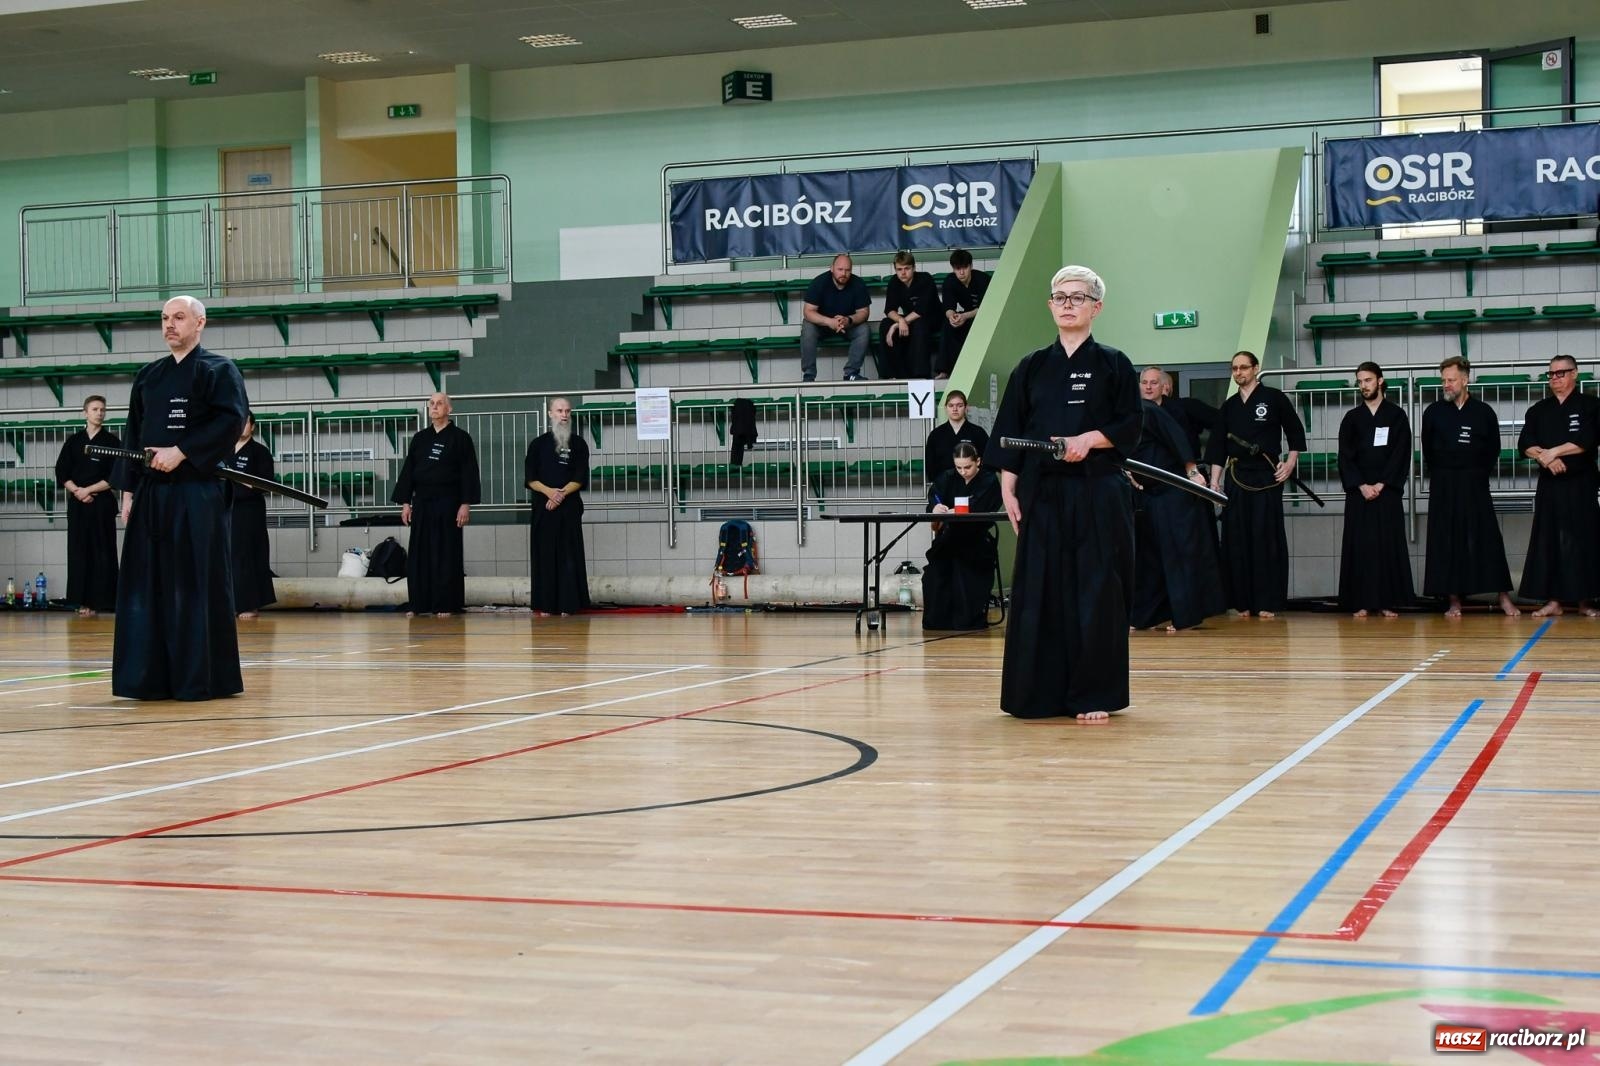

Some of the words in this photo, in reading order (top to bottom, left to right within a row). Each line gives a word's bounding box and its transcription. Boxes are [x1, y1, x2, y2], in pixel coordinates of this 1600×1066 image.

[725, 82, 733, 100] E
[746, 81, 763, 97] E
[1365, 152, 1474, 191] OSiR
[900, 181, 998, 217] OSiR
[1408, 188, 1475, 203] RACIBÓRZ
[705, 194, 852, 231] RACIBÓRZ
[938, 215, 998, 229] RACIBÓRZ
[911, 391, 931, 416] Y
